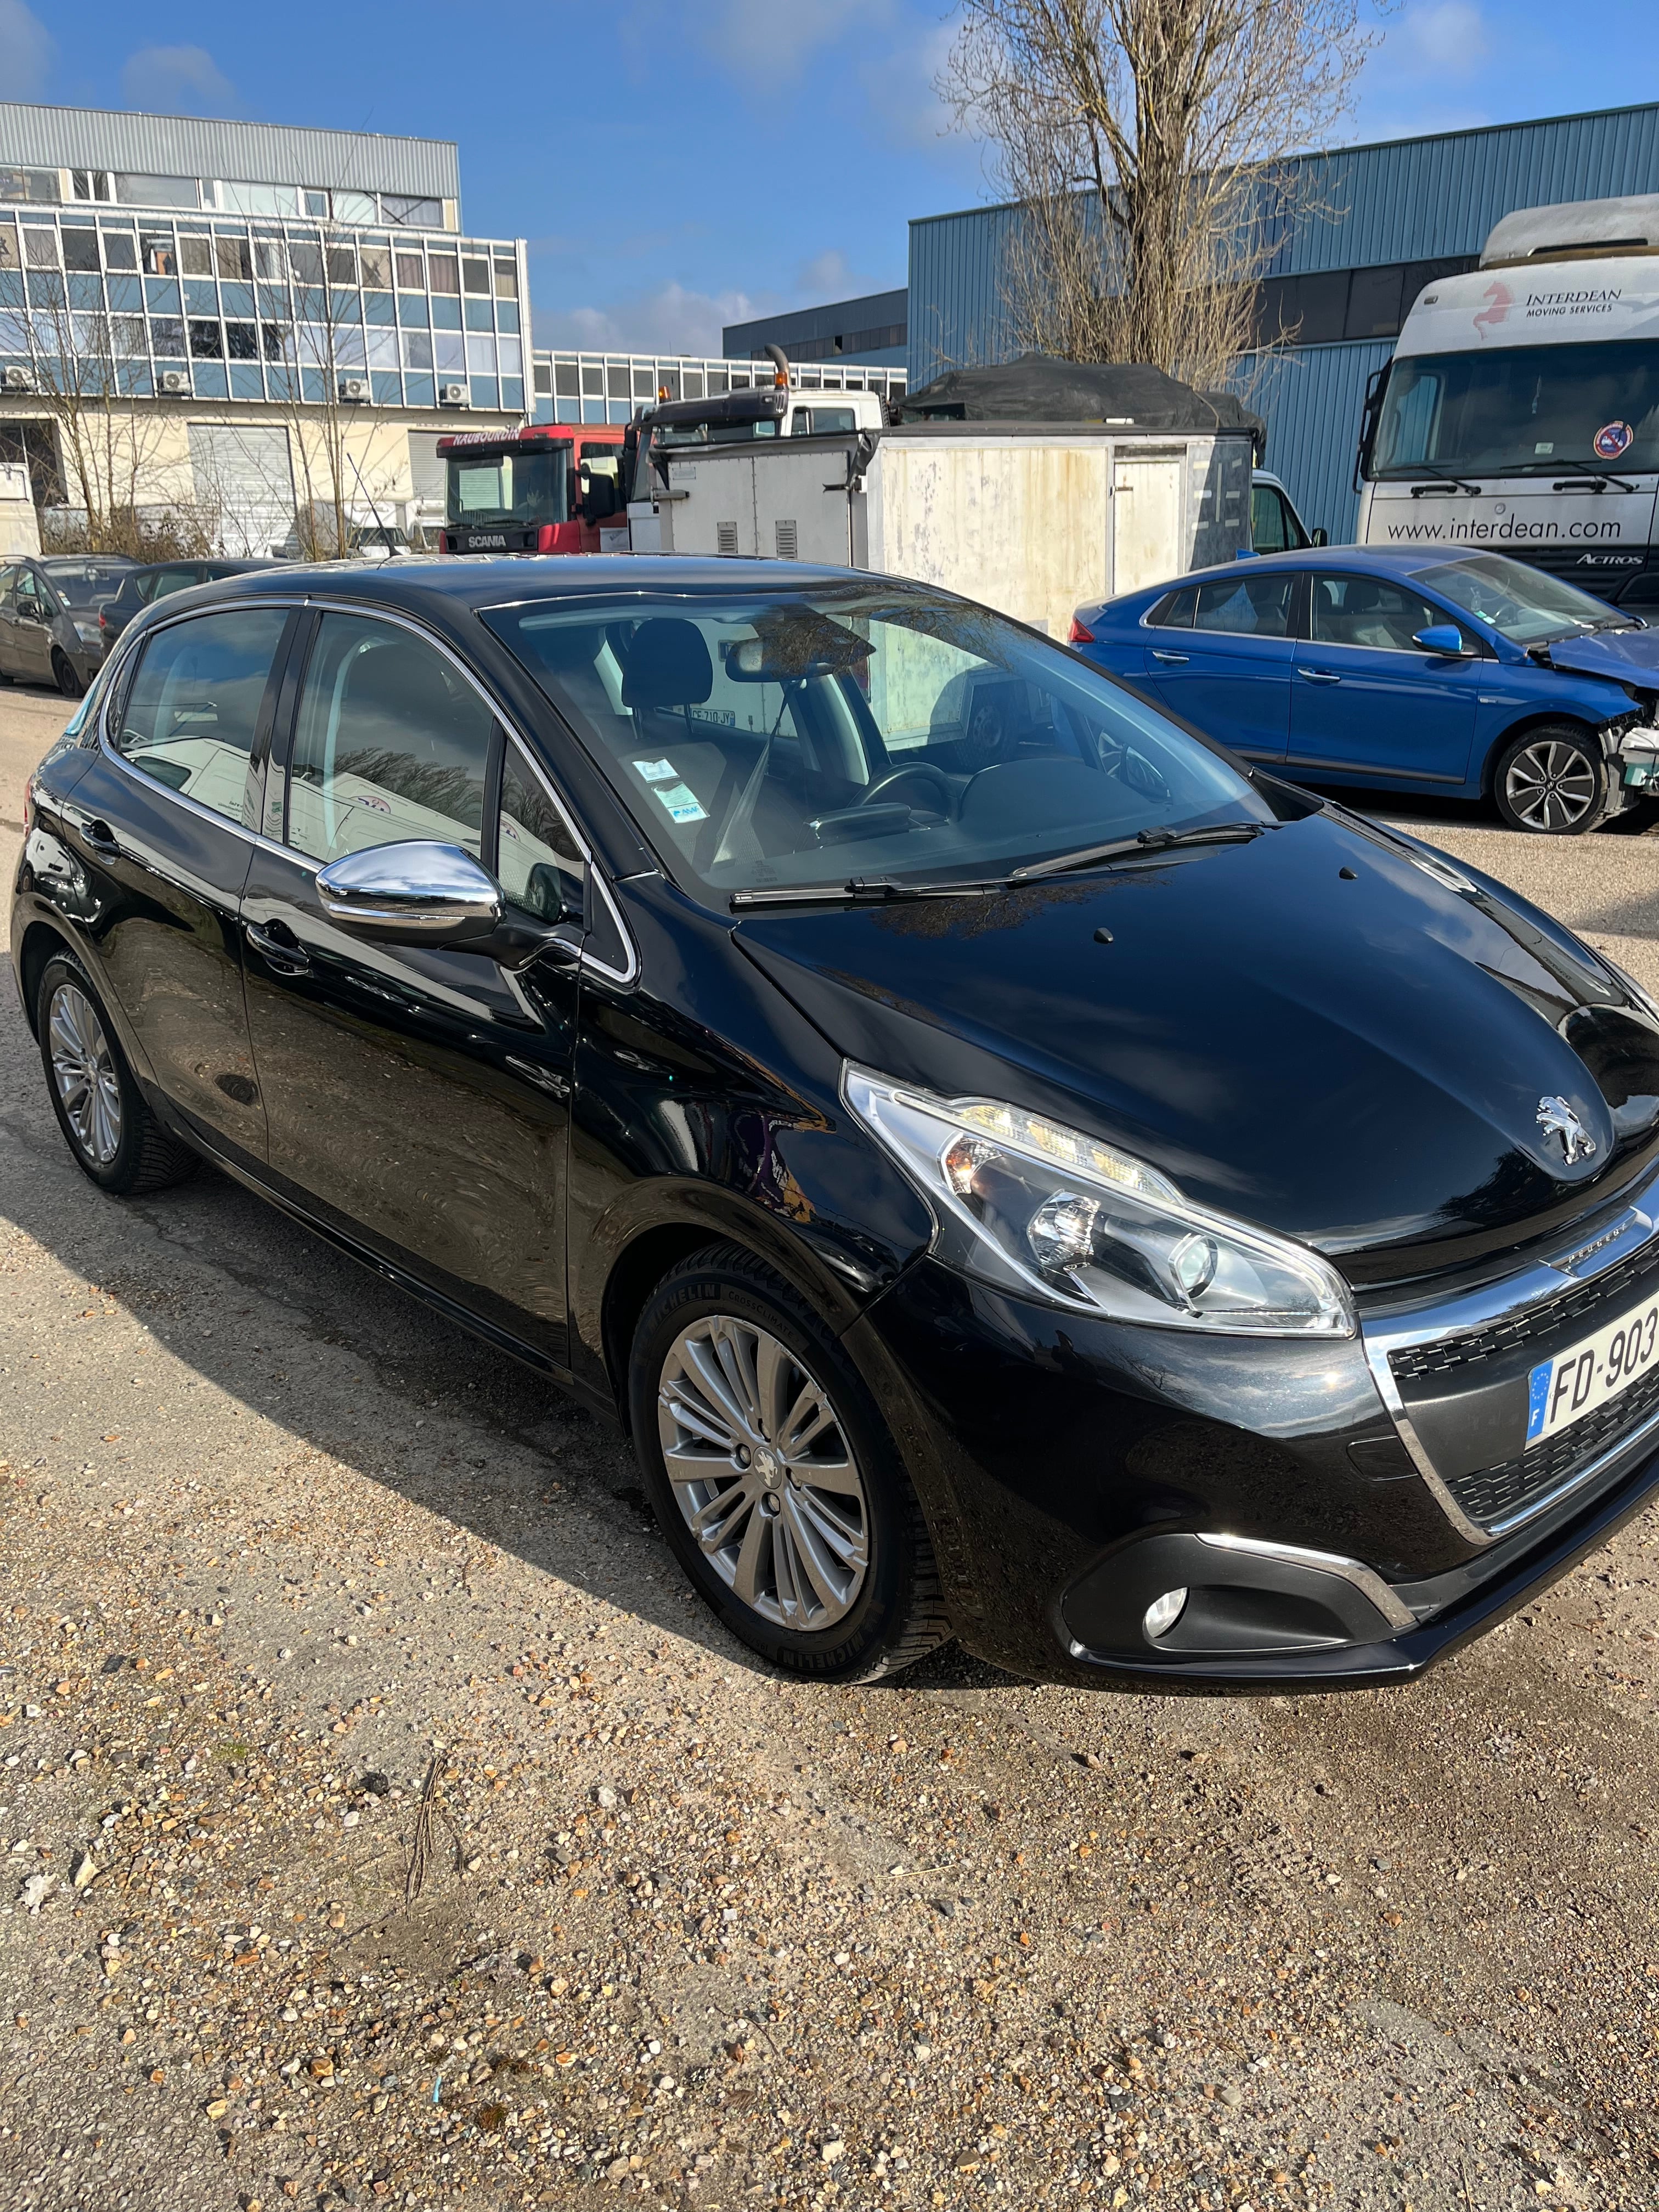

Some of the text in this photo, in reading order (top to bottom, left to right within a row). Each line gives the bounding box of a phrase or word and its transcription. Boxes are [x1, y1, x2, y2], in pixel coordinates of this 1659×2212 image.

[1526, 289, 1622, 307] INTERDEAN
[1526, 303, 1612, 318] MOVING SERVICES
[1388, 513, 1621, 540] www.interdean.com
[469, 535, 506, 548] SCANIA
[1576, 553, 1644, 565] ACTROS
[1568, 1223, 1626, 1263] PEUGEOT
[649, 1284, 715, 1330] MICHELIN
[1550, 1307, 1658, 1424] FD-903
[1531, 1408, 1539, 1426] F
[783, 1630, 865, 1668] MICHELIN
